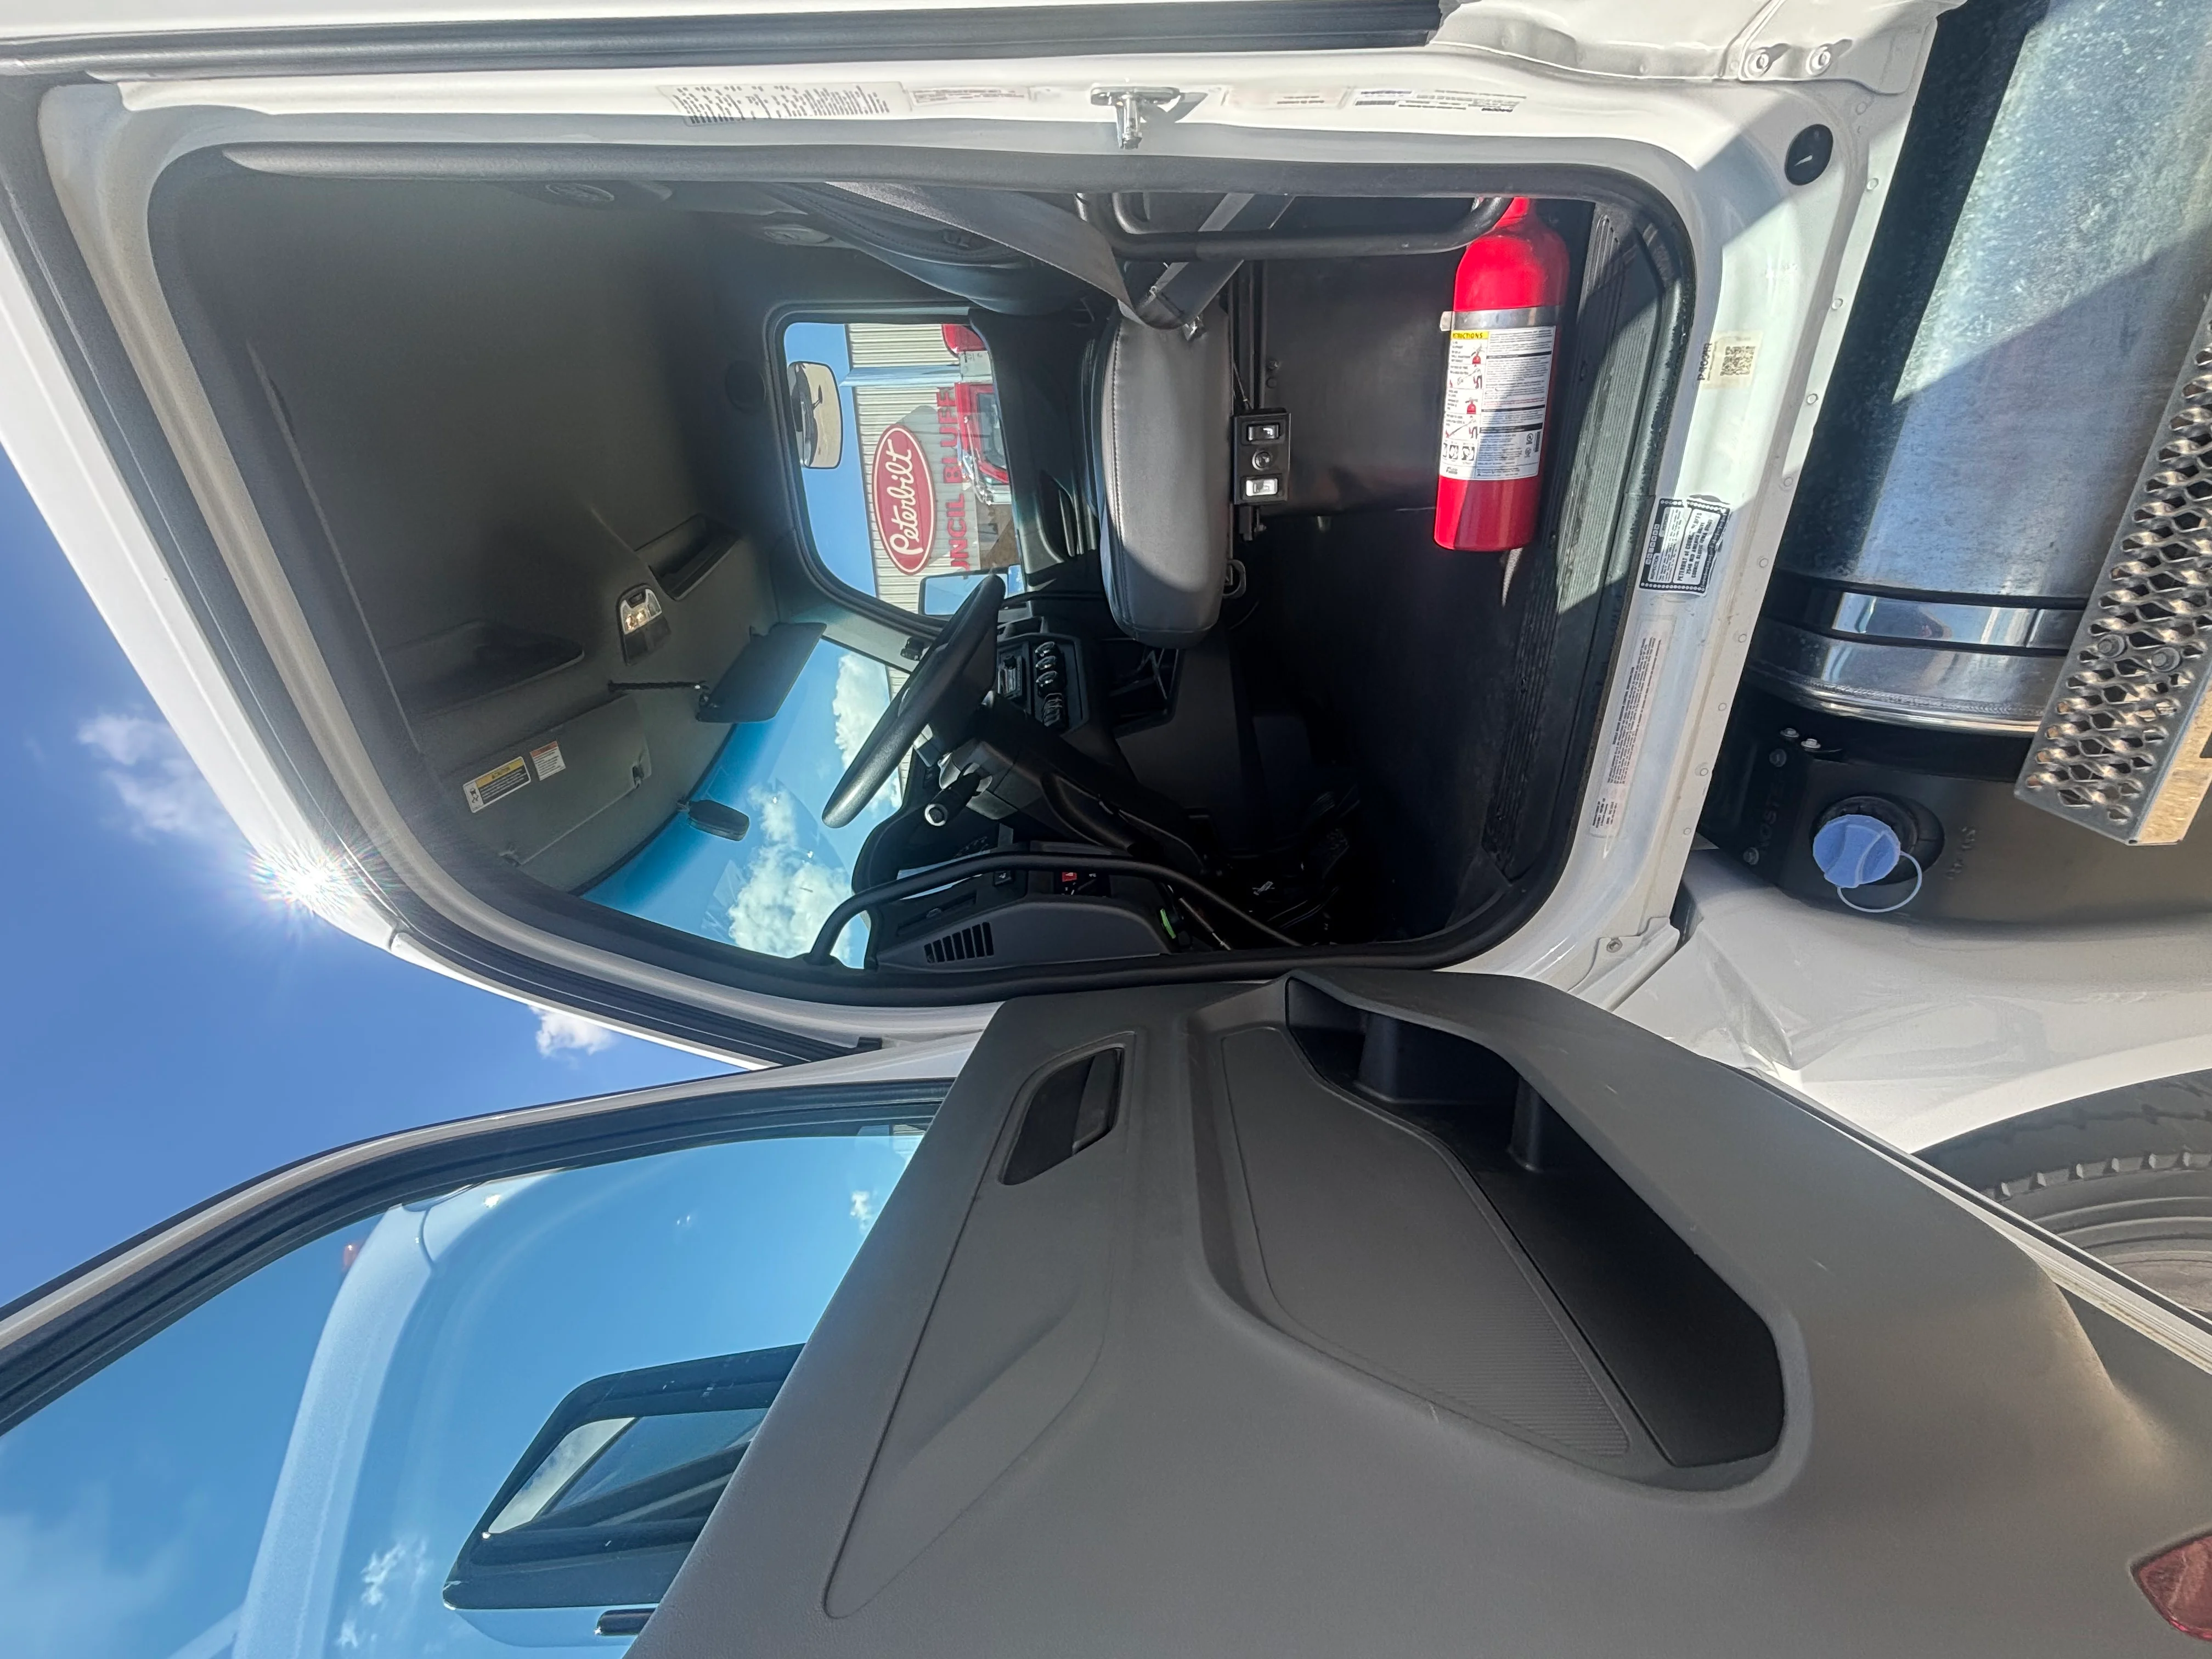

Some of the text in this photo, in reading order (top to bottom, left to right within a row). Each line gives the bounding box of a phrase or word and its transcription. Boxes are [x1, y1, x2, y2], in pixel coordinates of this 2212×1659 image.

[885, 438, 924, 555] Peterbilt
[936, 387, 970, 571] UNCIL BLUFF
[1677, 557, 1688, 582] PETERBILT
